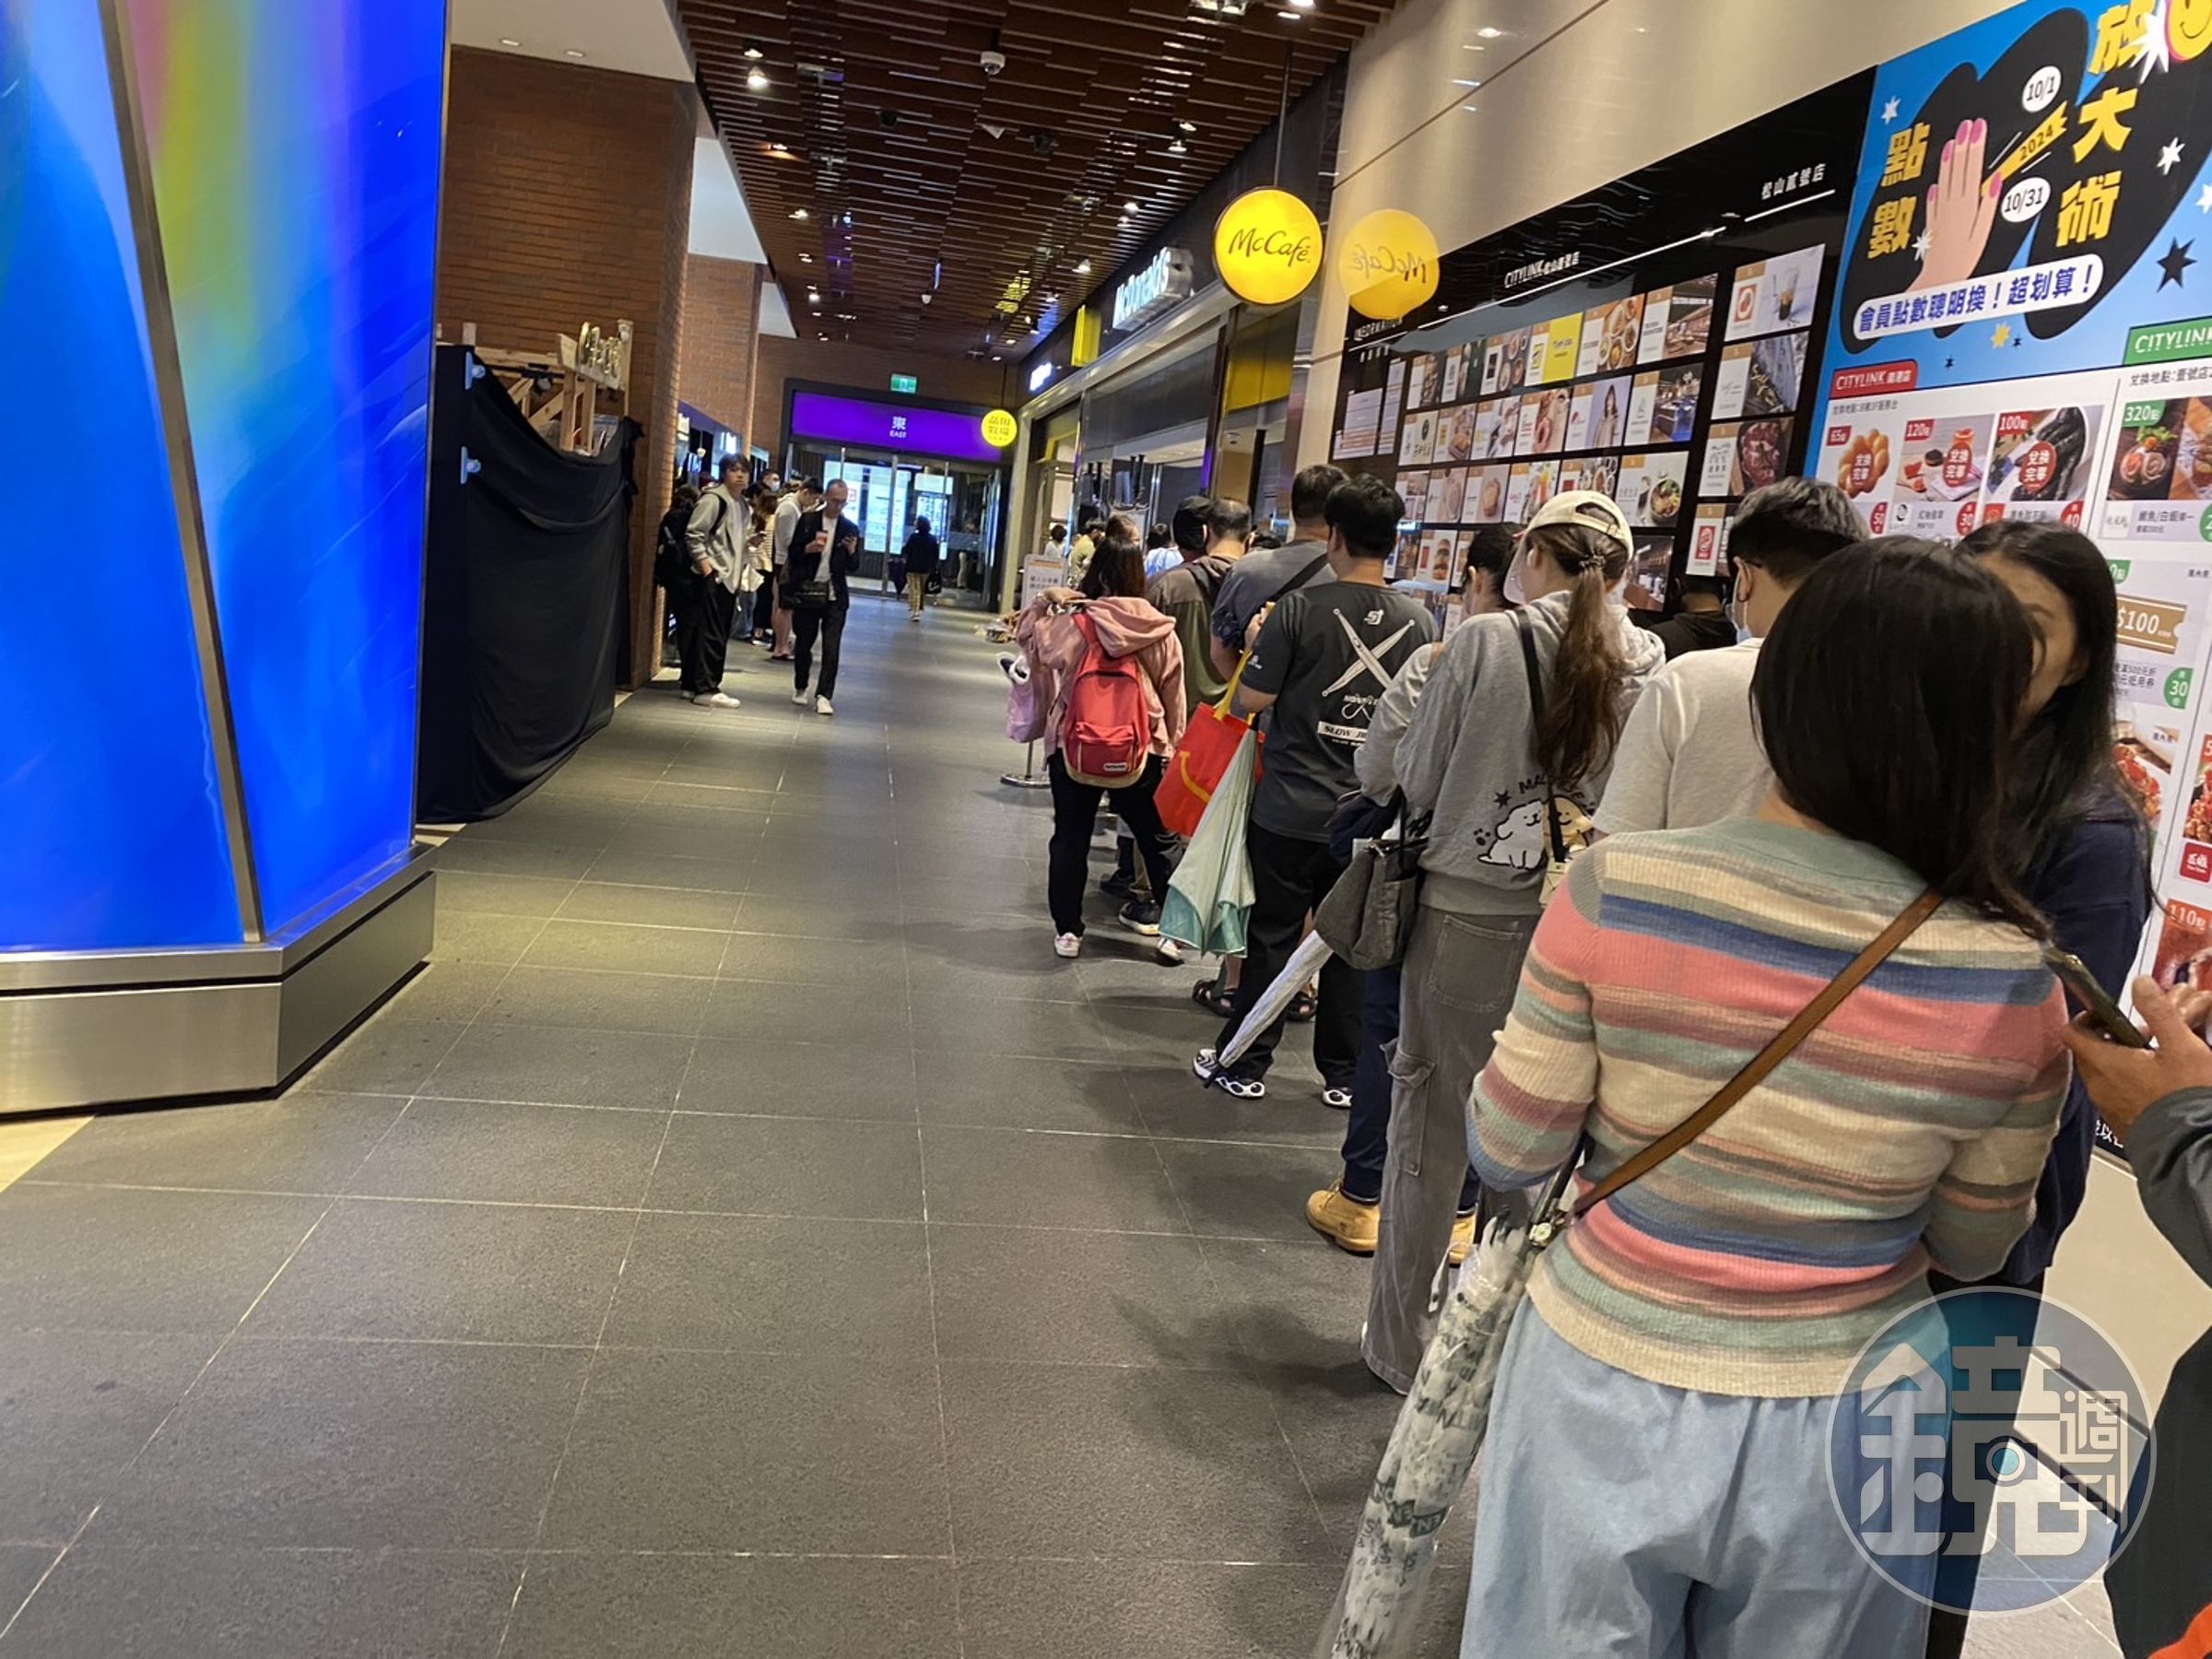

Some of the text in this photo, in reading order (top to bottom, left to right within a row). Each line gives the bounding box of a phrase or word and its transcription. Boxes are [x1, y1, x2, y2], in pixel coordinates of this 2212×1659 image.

[2026, 76, 2056, 101] 10/1
[2019, 124, 2055, 161] 2024
[1867, 122, 1931, 260] 點數
[2003, 190, 2044, 213] 10/31
[1228, 228, 1312, 267] McCafé
[1835, 371, 1886, 391] CITYLINK
[2169, 680, 2189, 697] 30
